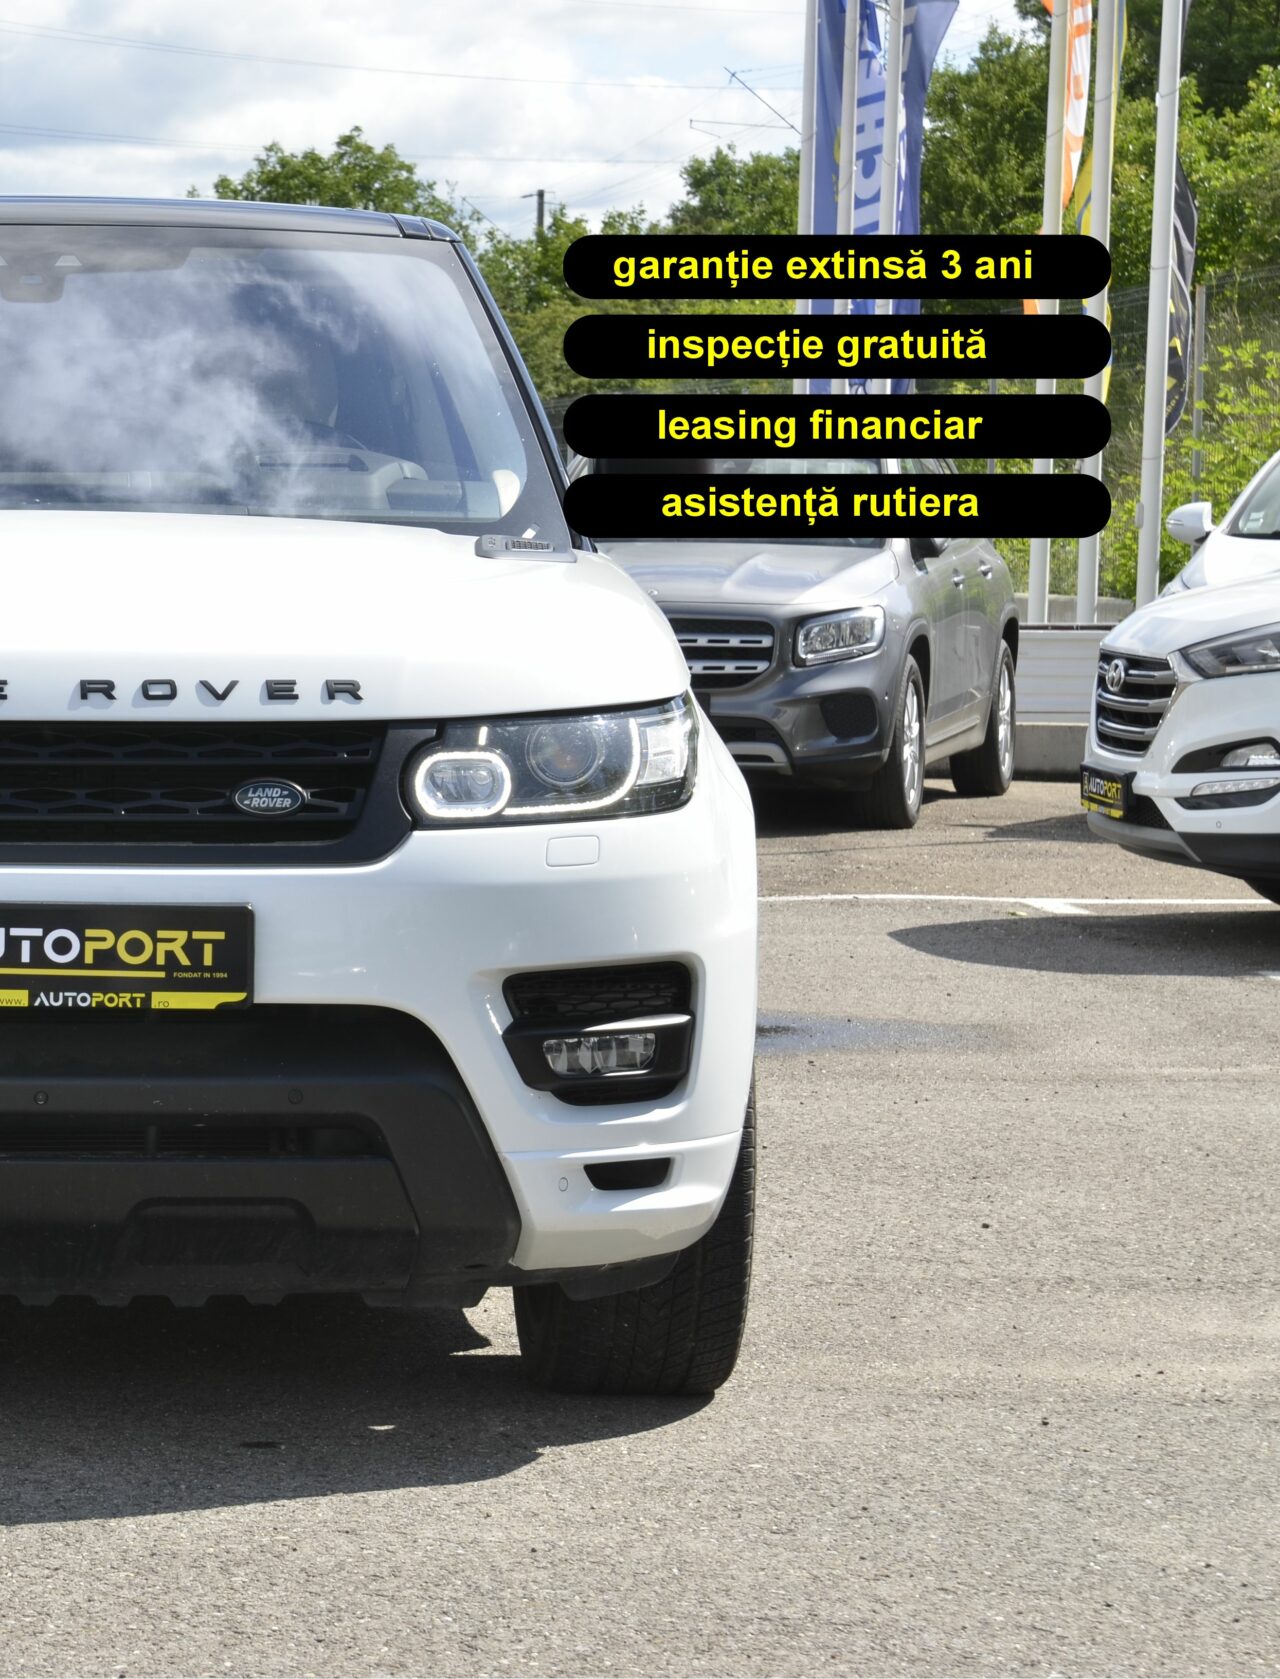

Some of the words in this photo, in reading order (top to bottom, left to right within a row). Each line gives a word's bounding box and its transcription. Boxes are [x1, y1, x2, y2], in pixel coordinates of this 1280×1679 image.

[79, 678, 365, 701] ROVER
[247, 787, 281, 798] LAND
[1089, 776, 1122, 800] AUTOPORT
[250, 798, 292, 808] ROVER
[34, 992, 145, 1008] AUTOPORT
